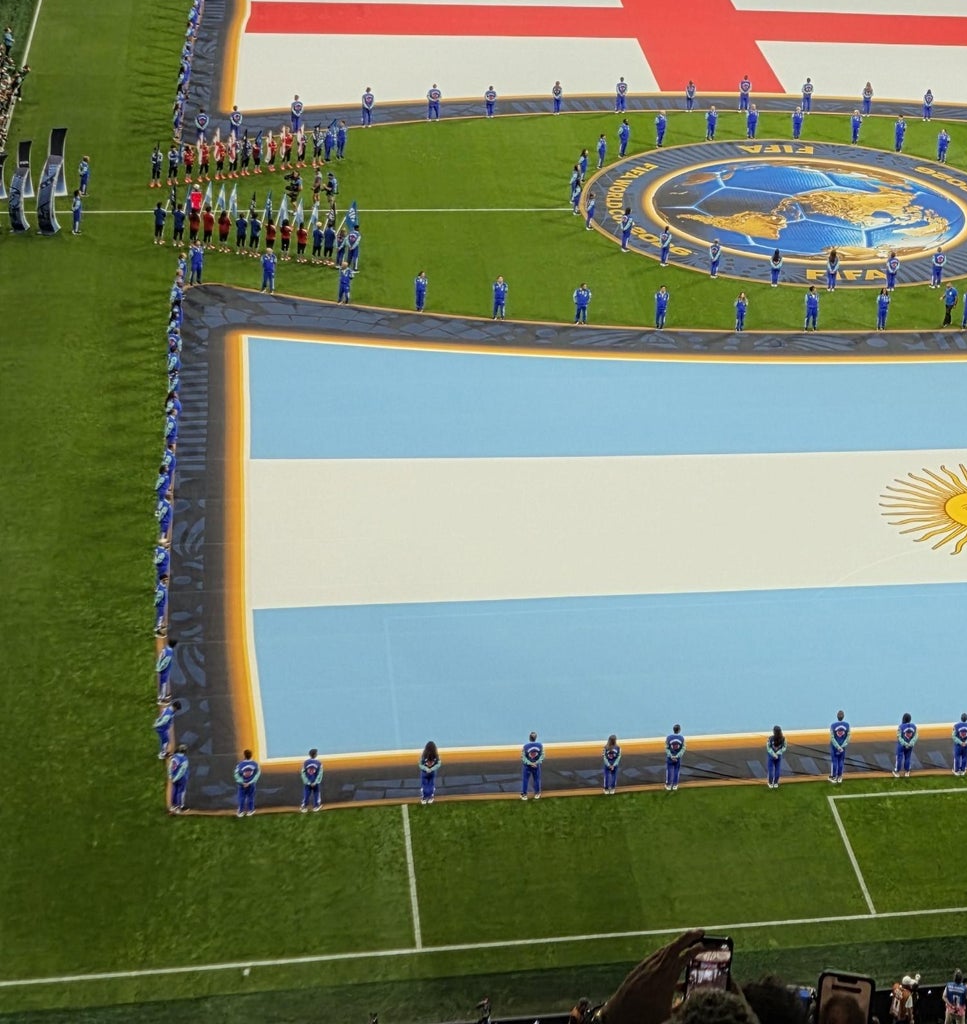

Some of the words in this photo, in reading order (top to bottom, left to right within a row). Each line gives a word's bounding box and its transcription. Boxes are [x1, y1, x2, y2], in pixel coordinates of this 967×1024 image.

[737, 144, 814, 155] FIFA
[620, 162, 658, 179] FIFA
[606, 179, 633, 208] WORLD
